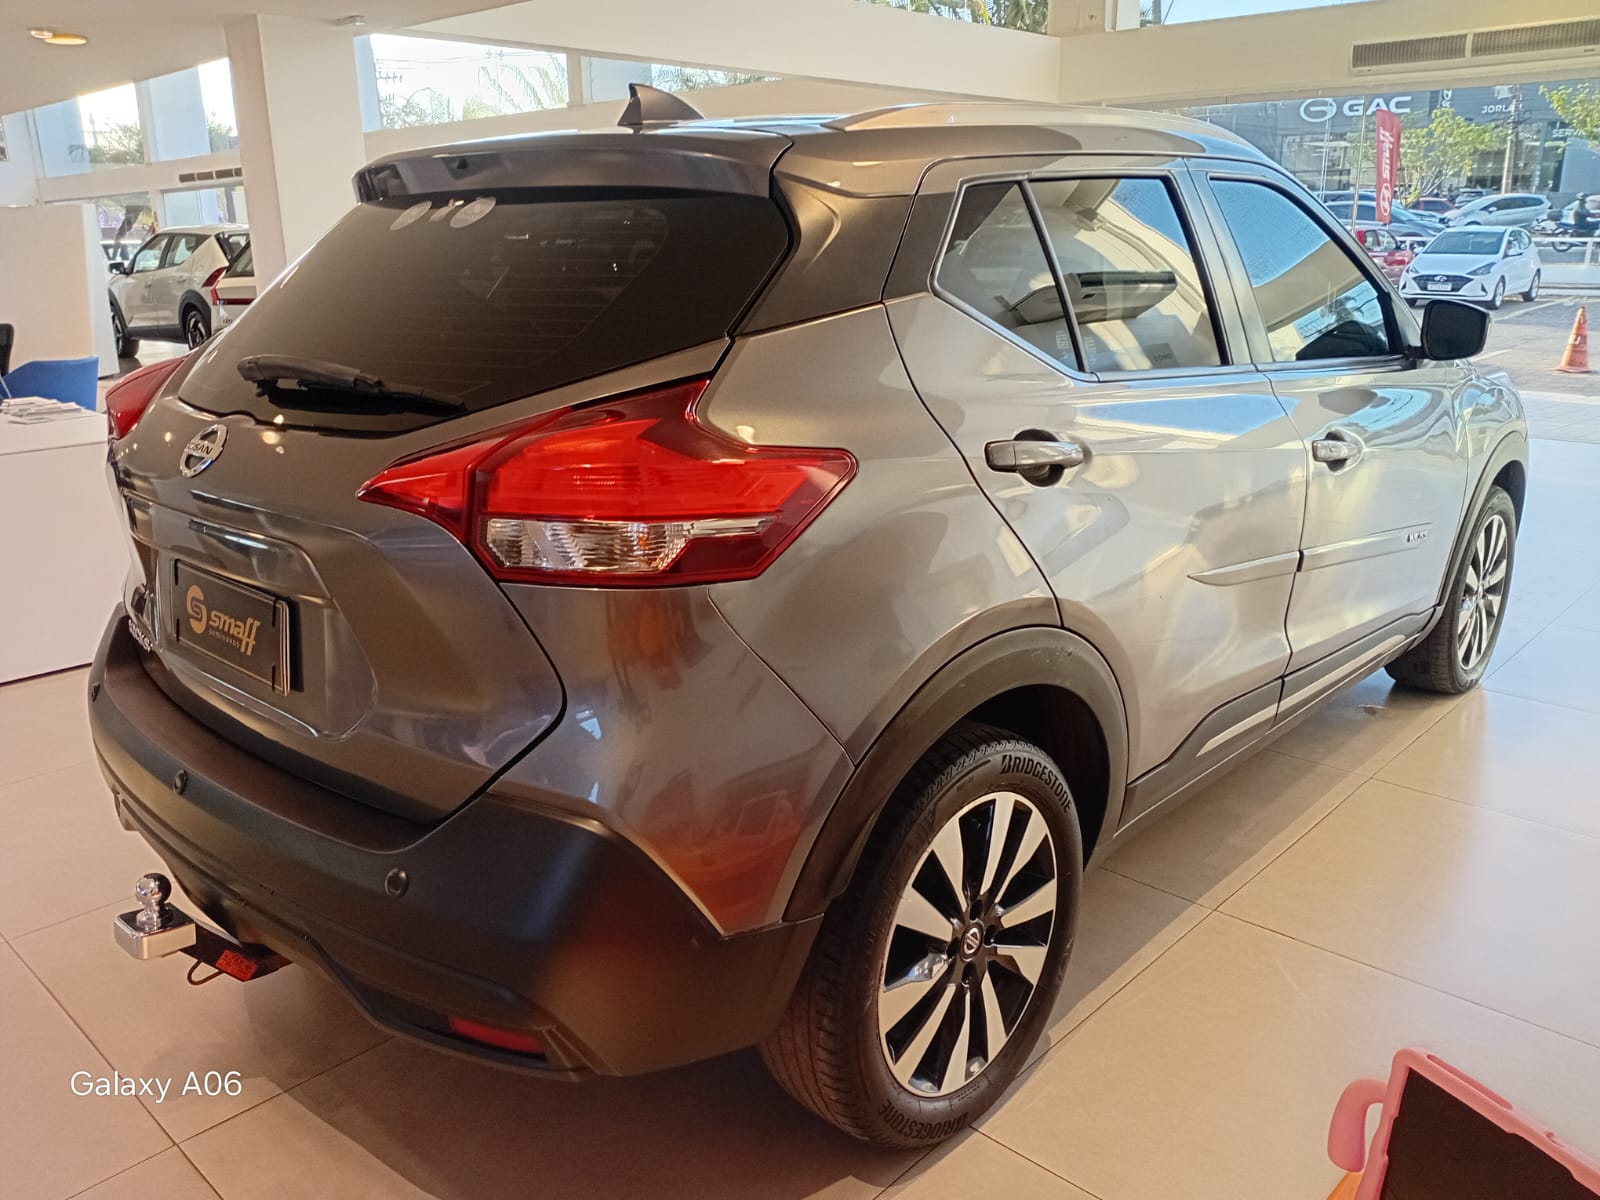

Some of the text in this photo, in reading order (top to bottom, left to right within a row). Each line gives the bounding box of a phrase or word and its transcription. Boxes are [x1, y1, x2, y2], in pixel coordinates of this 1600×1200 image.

[1342, 95, 1412, 117] GAC
[209, 610, 261, 656] smaff
[1000, 754, 1073, 813] BRIDGESTONE
[880, 1098, 969, 1139] BRIDGESTONE
